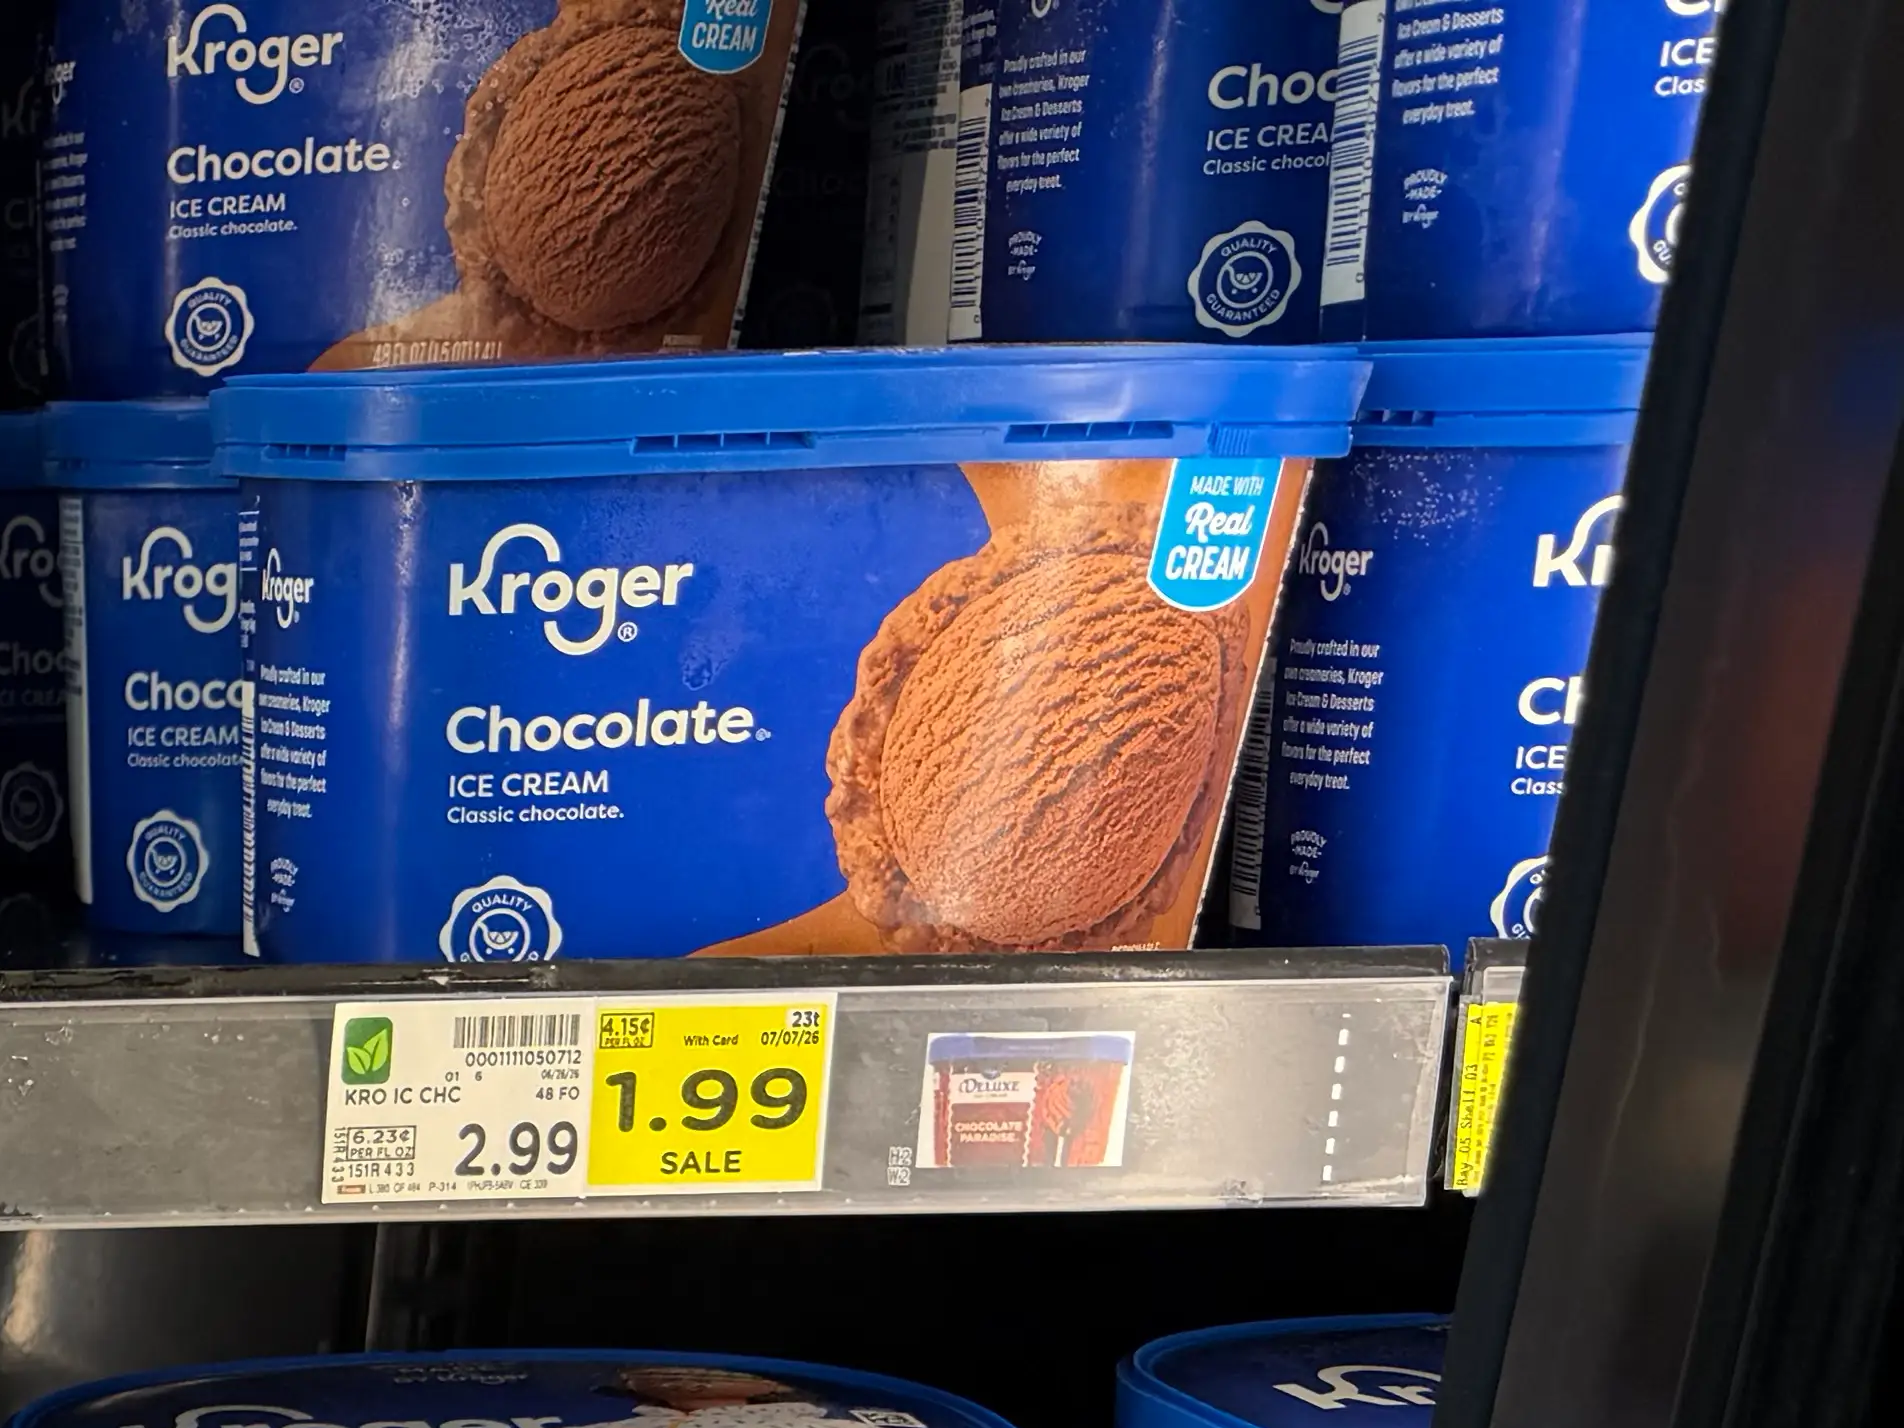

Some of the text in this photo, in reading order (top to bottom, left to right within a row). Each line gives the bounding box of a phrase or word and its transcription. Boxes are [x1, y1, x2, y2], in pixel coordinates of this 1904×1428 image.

[167, 3, 343, 105] Kroger
[167, 138, 390, 185] Chocolate
[1190, 475, 1265, 496] MADE WITH
[1185, 503, 1254, 538] Real
[1165, 544, 1250, 584] CREAM
[1299, 522, 1374, 602] Kroger
[448, 523, 694, 656] Kroger
[445, 697, 755, 754] Chocolate
[448, 770, 610, 798] ICE CREAM
[447, 802, 625, 825] Classic chocolate.
[601, 1017, 651, 1036] 4.15¢
[793, 1011, 820, 1028] 23t
[761, 1030, 819, 1046] 07/07/26
[465, 1050, 581, 1067] 0001111050712
[345, 1087, 461, 1106] KRO IC CHC
[606, 1067, 808, 1132] 1.99
[955, 1122, 1022, 1132] CHOCOLATE
[455, 1121, 578, 1177] 2.99
[660, 1151, 742, 1174] SALE
